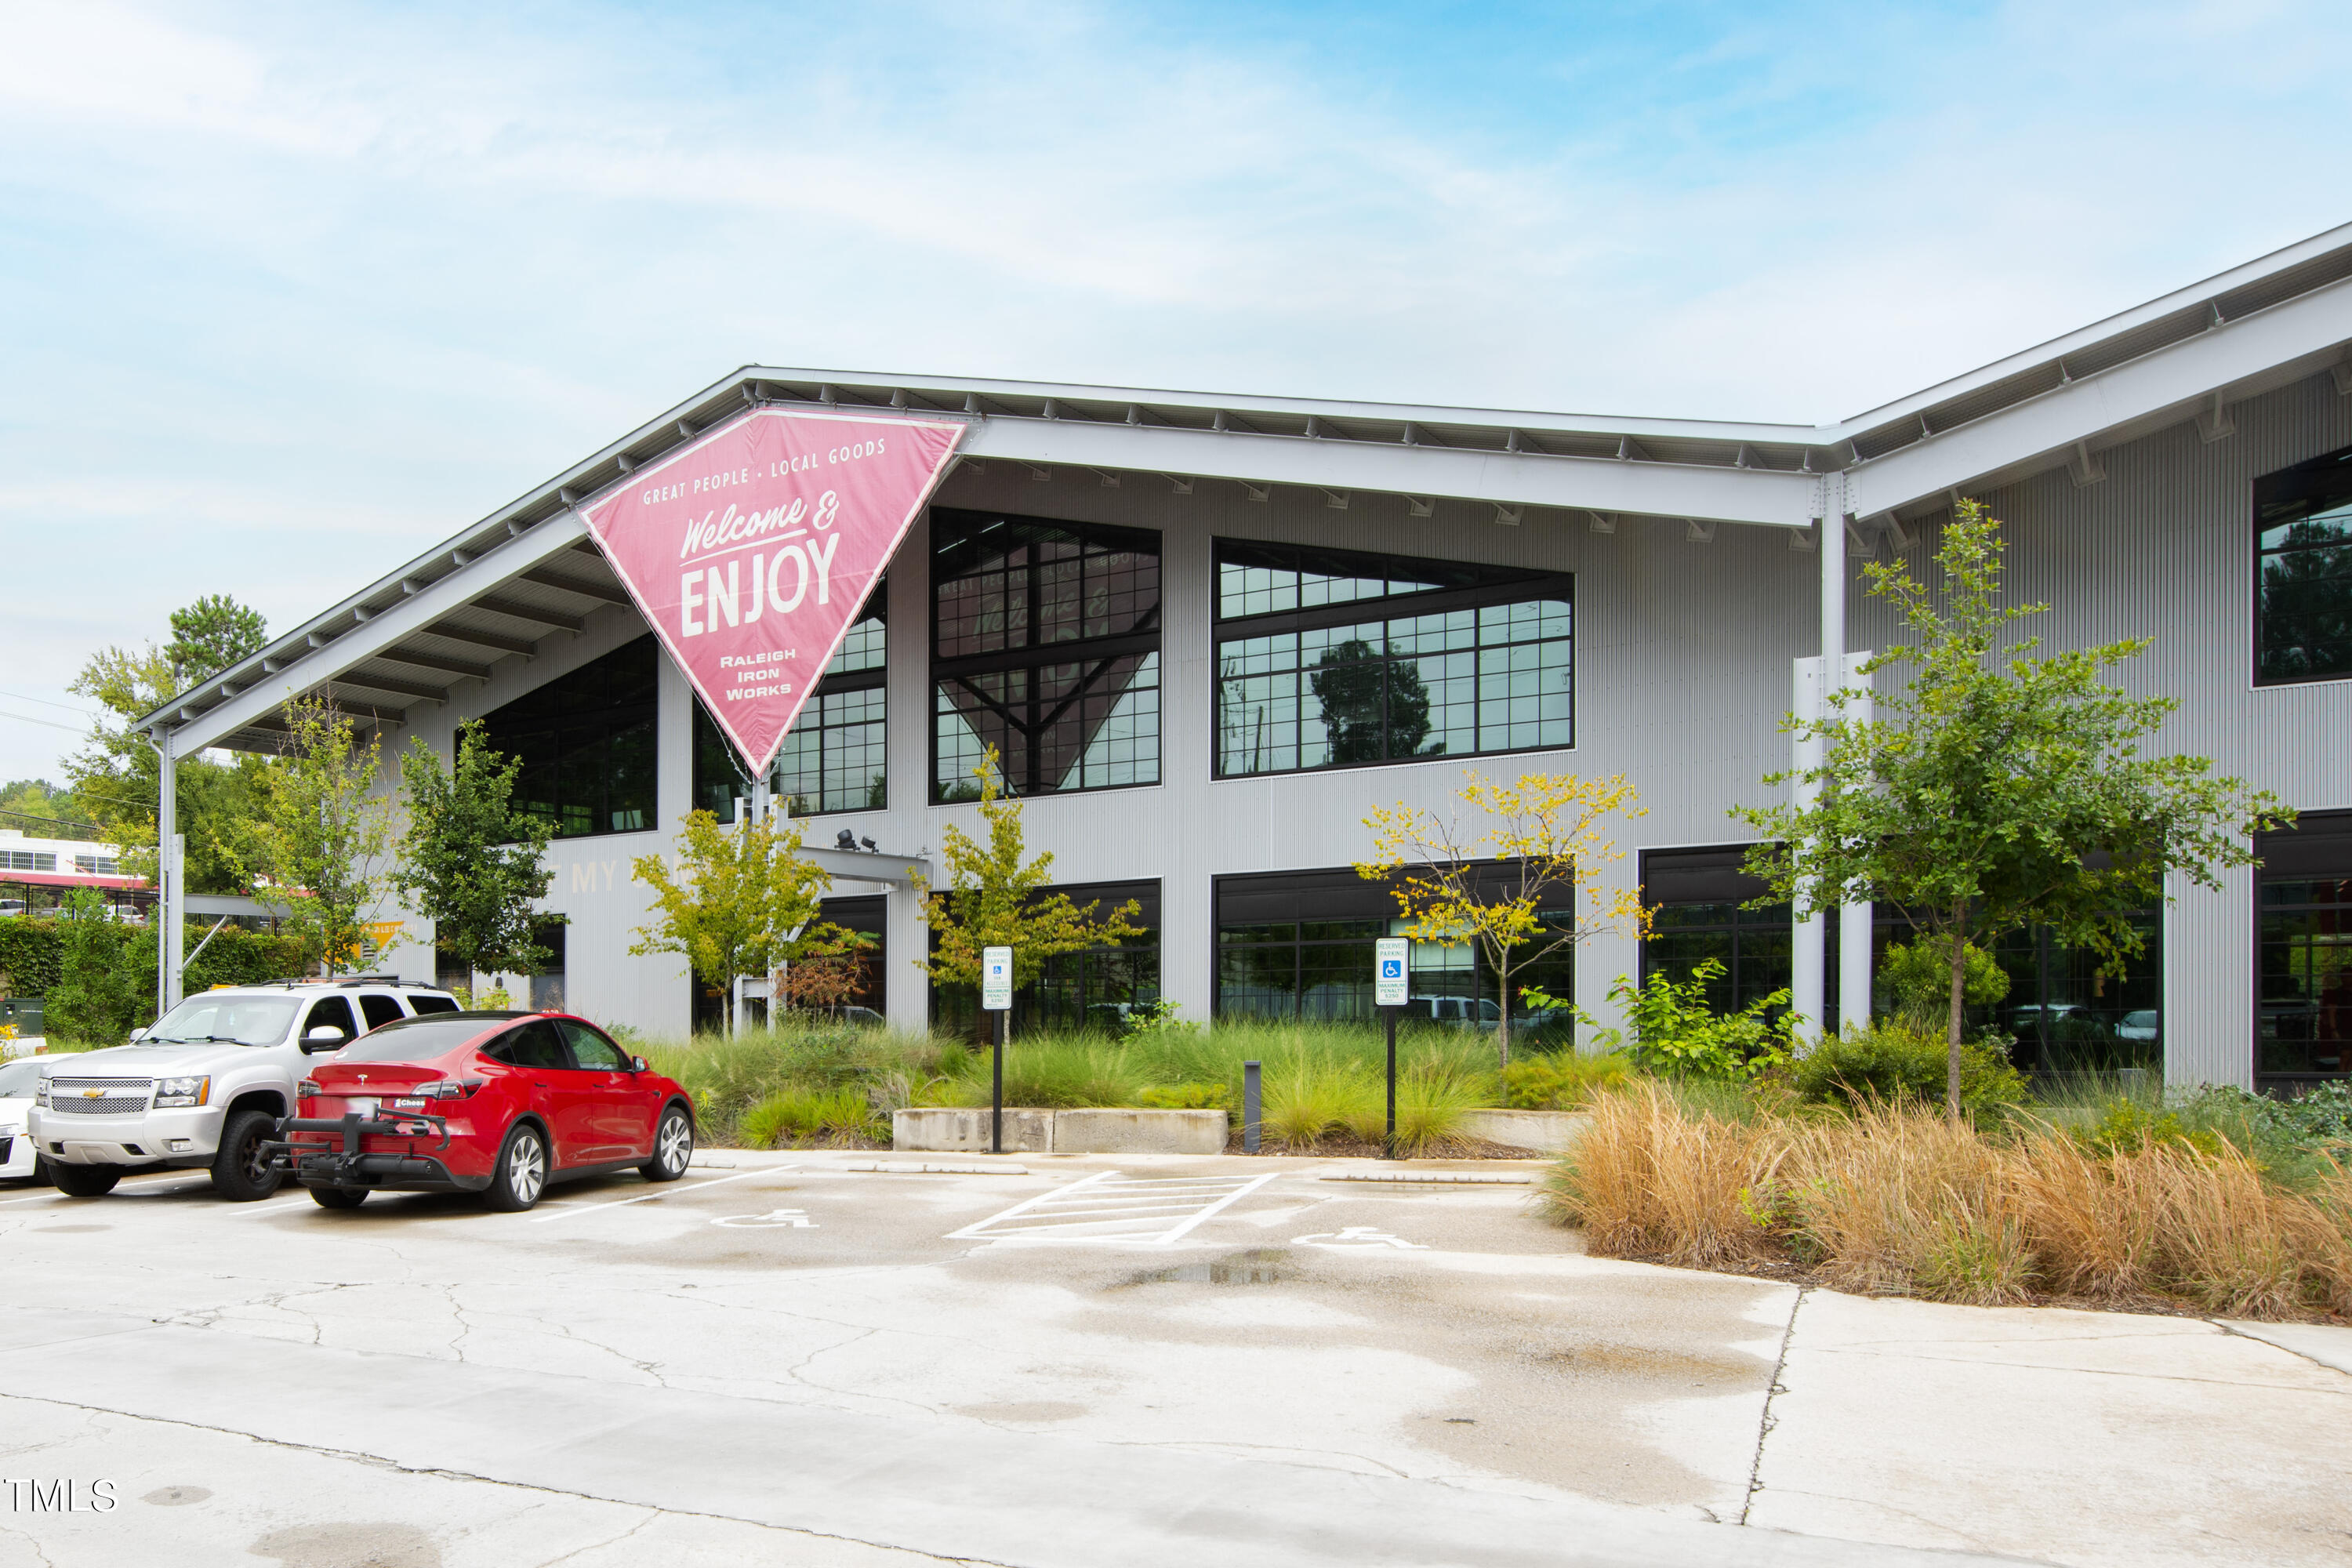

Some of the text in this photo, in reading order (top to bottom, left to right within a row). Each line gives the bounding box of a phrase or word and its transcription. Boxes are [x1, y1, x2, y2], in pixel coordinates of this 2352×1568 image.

[643, 437, 886, 506] GREAT PEOPLE LOCAL GOODS
[680, 489, 840, 559] Welcome &
[681, 532, 840, 638] ENJOY
[720, 648, 796, 669] RALEIGH
[737, 668, 779, 683] IRON
[726, 684, 792, 701] WORKS
[572, 859, 617, 894] MY
